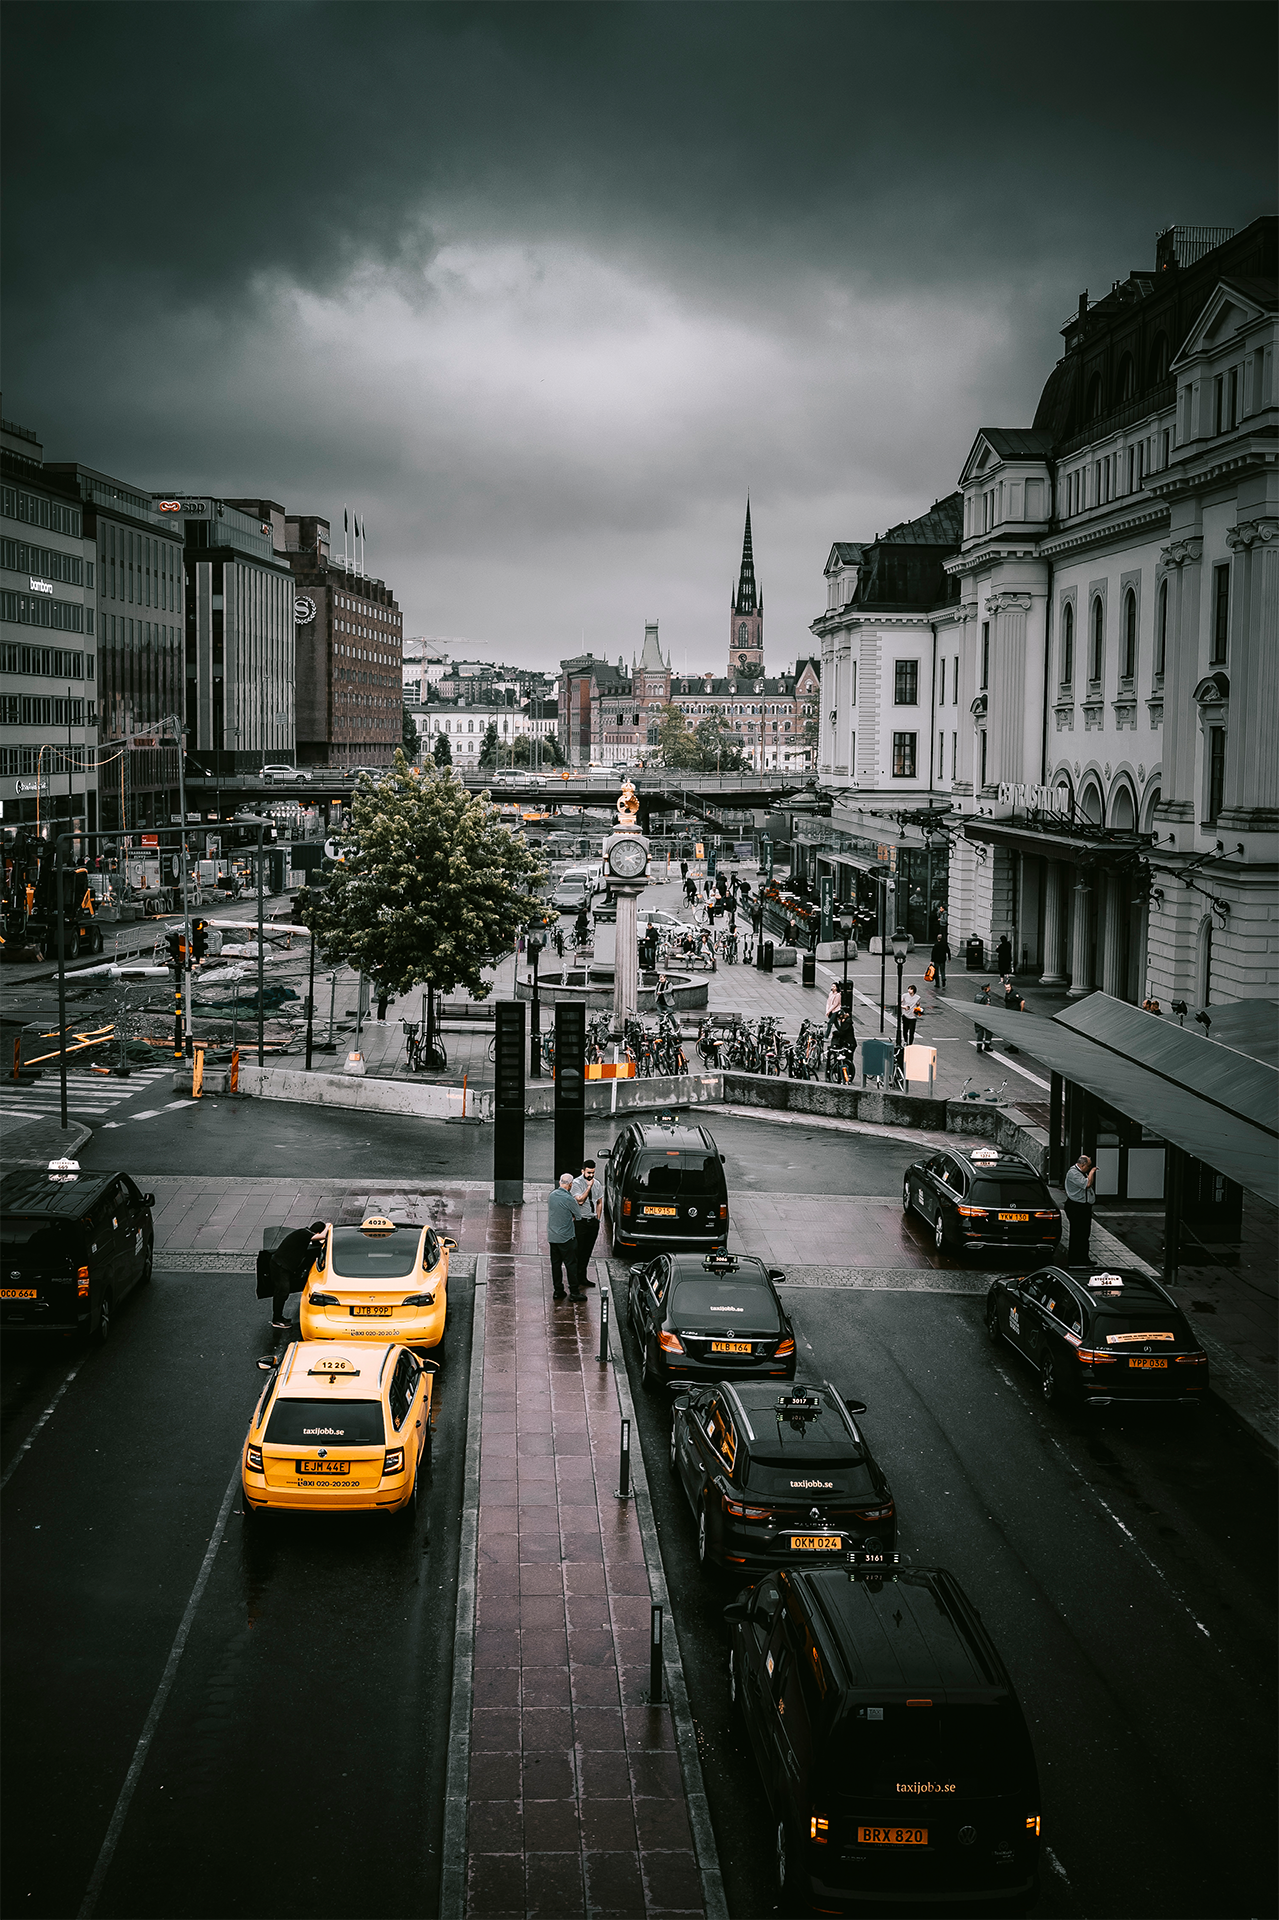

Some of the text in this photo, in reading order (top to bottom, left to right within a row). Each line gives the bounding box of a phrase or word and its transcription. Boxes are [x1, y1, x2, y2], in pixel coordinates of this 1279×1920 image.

[182, 502, 206, 515] spp
[19, 1290, 34, 1298] 664
[710, 1305, 744, 1313] taxijobb.se
[715, 1342, 748, 1352] YLB 164
[1131, 1359, 1165, 1367] YPP 036
[303, 1427, 345, 1436] taxijobb.se
[304, 1461, 346, 1472] EJM 44E
[790, 1480, 834, 1489] taxijobb.se
[794, 1538, 837, 1548] OKM 024
[865, 1554, 884, 1562] 3161
[863, 1828, 923, 1844] BRX 820
